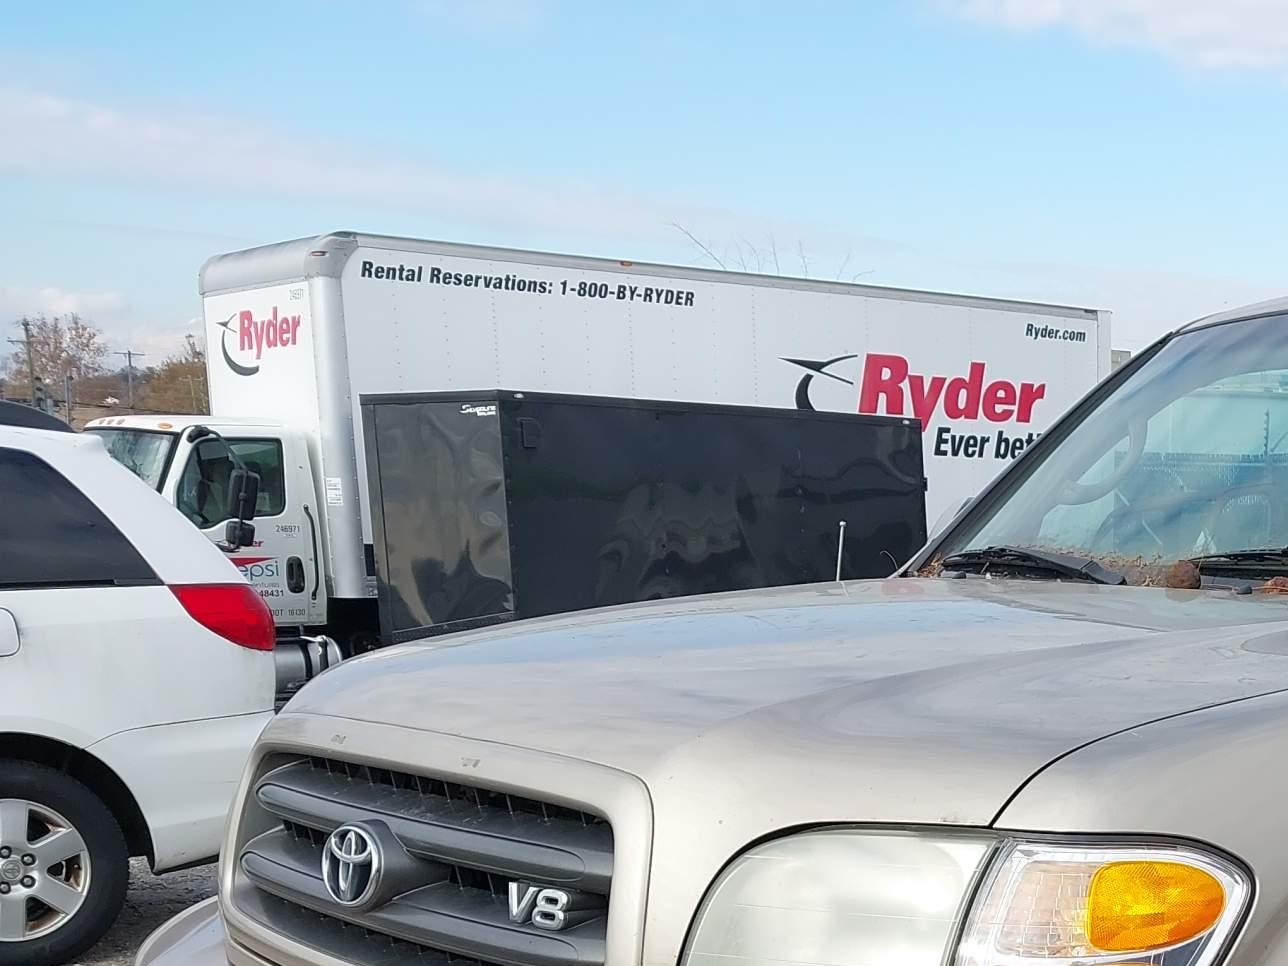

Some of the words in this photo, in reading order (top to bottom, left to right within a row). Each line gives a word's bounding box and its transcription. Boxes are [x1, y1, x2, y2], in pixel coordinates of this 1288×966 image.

[361, 260, 423, 283] Rental
[430, 267, 553, 294] Reservations:
[560, 279, 695, 307] 1-800-BY-RYDER
[239, 305, 301, 360] Ryder
[1025, 323, 1087, 342] Ryder.com
[858, 353, 1046, 433] Ryder
[934, 426, 990, 459] Ever
[994, 430, 1043, 460] bet
[238, 560, 279, 581] epsi
[509, 882, 569, 931] V8
